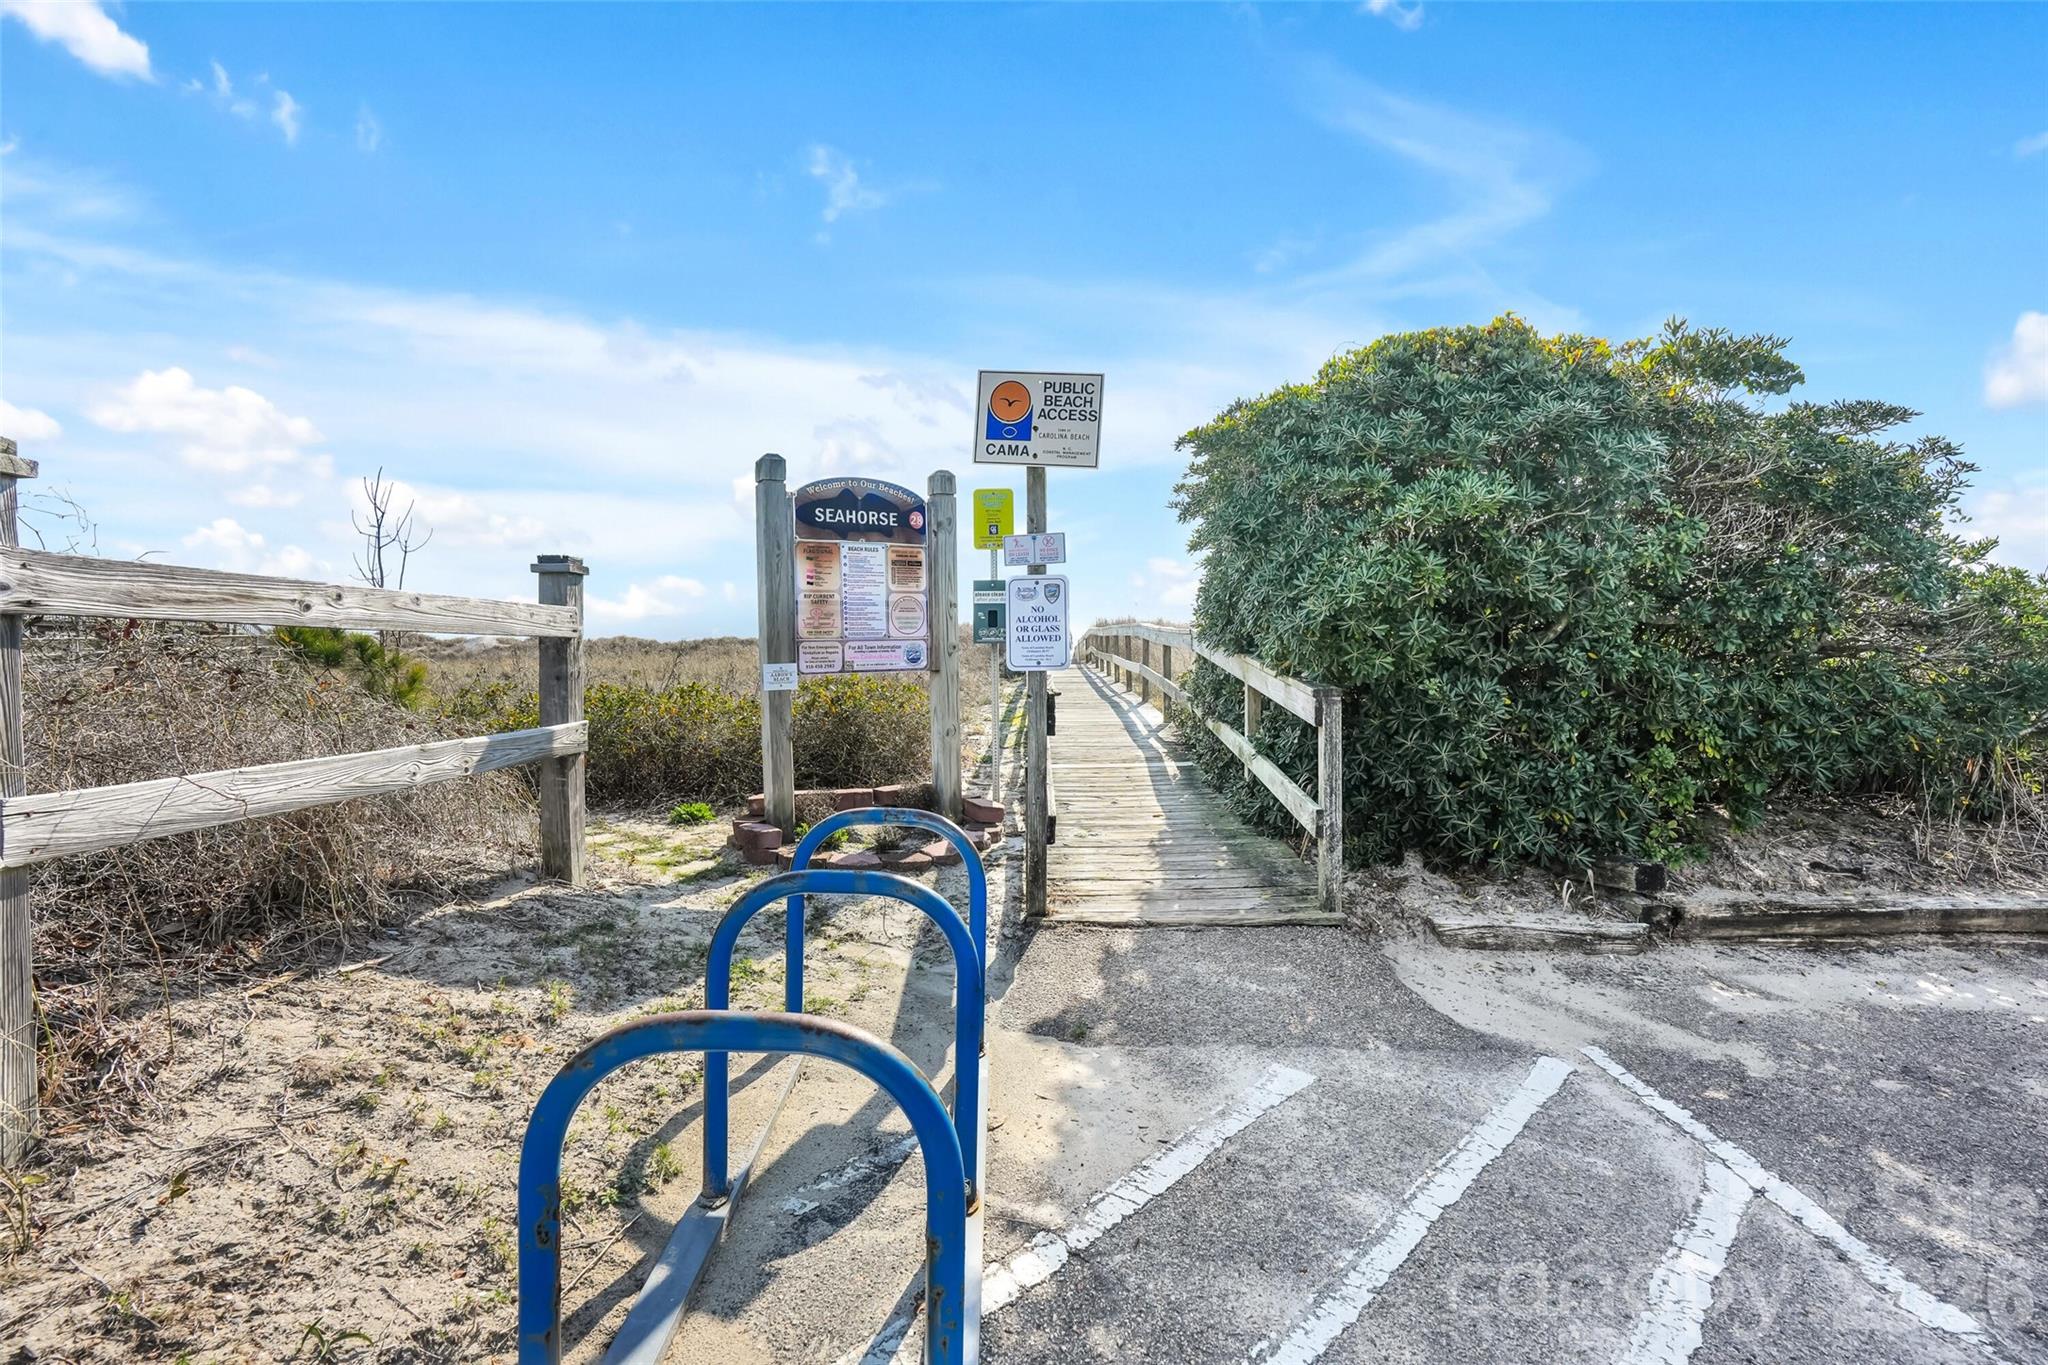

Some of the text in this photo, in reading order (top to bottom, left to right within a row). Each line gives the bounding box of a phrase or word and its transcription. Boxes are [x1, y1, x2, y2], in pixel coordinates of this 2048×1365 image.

[1043, 381, 1096, 395] PUBLIC
[1043, 394, 1093, 408] BEACH
[1037, 408, 1099, 422] ACCESS
[1038, 432, 1068, 440] CAROLINA
[985, 442, 1030, 457] CAMA
[806, 479, 846, 495] Welcome
[848, 479, 858, 487] to
[860, 479, 876, 489] Our
[814, 507, 898, 526] SEAHORSE
[910, 514, 923, 525] 28
[1031, 605, 1045, 613] NO
[1015, 615, 1061, 624] ALCOHOL
[1015, 625, 1061, 633] OR GLASS
[1015, 634, 1062, 643] ALLOWED
